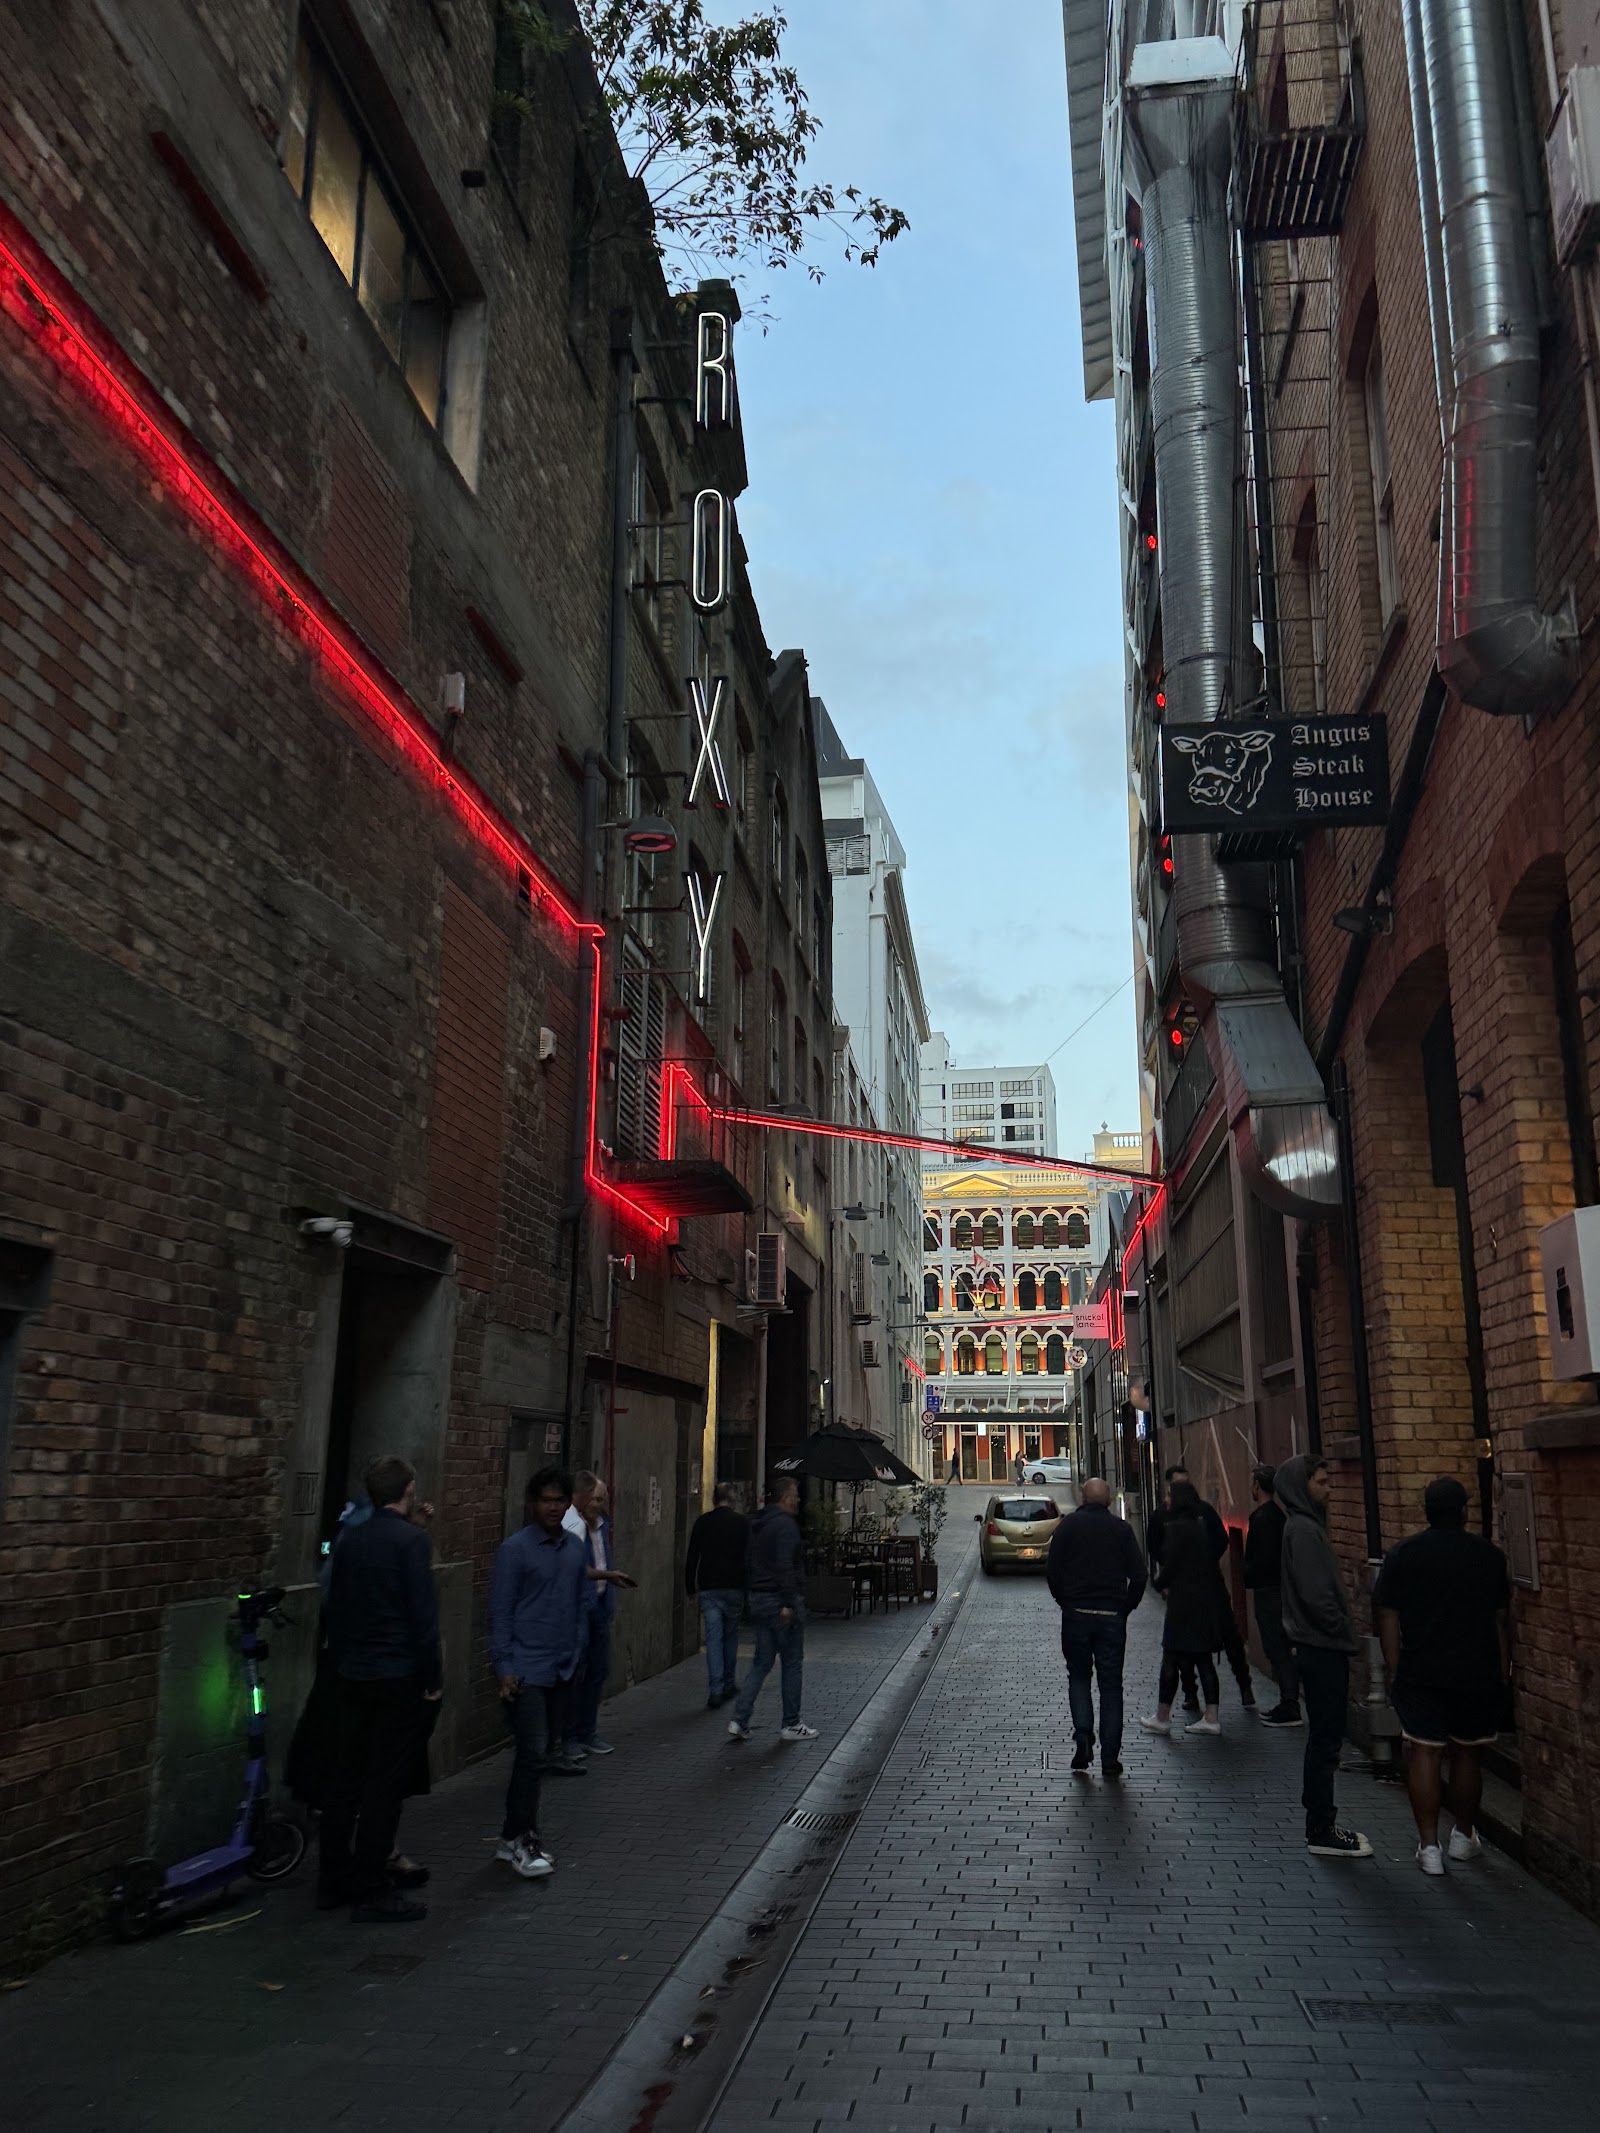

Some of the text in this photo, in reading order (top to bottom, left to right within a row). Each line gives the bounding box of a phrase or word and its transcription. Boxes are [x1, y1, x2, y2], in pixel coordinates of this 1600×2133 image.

[688, 310, 733, 1001] ROXY
[1290, 724, 1371, 747] Angus
[1292, 754, 1365, 778] Steak
[1293, 787, 1374, 811] House
